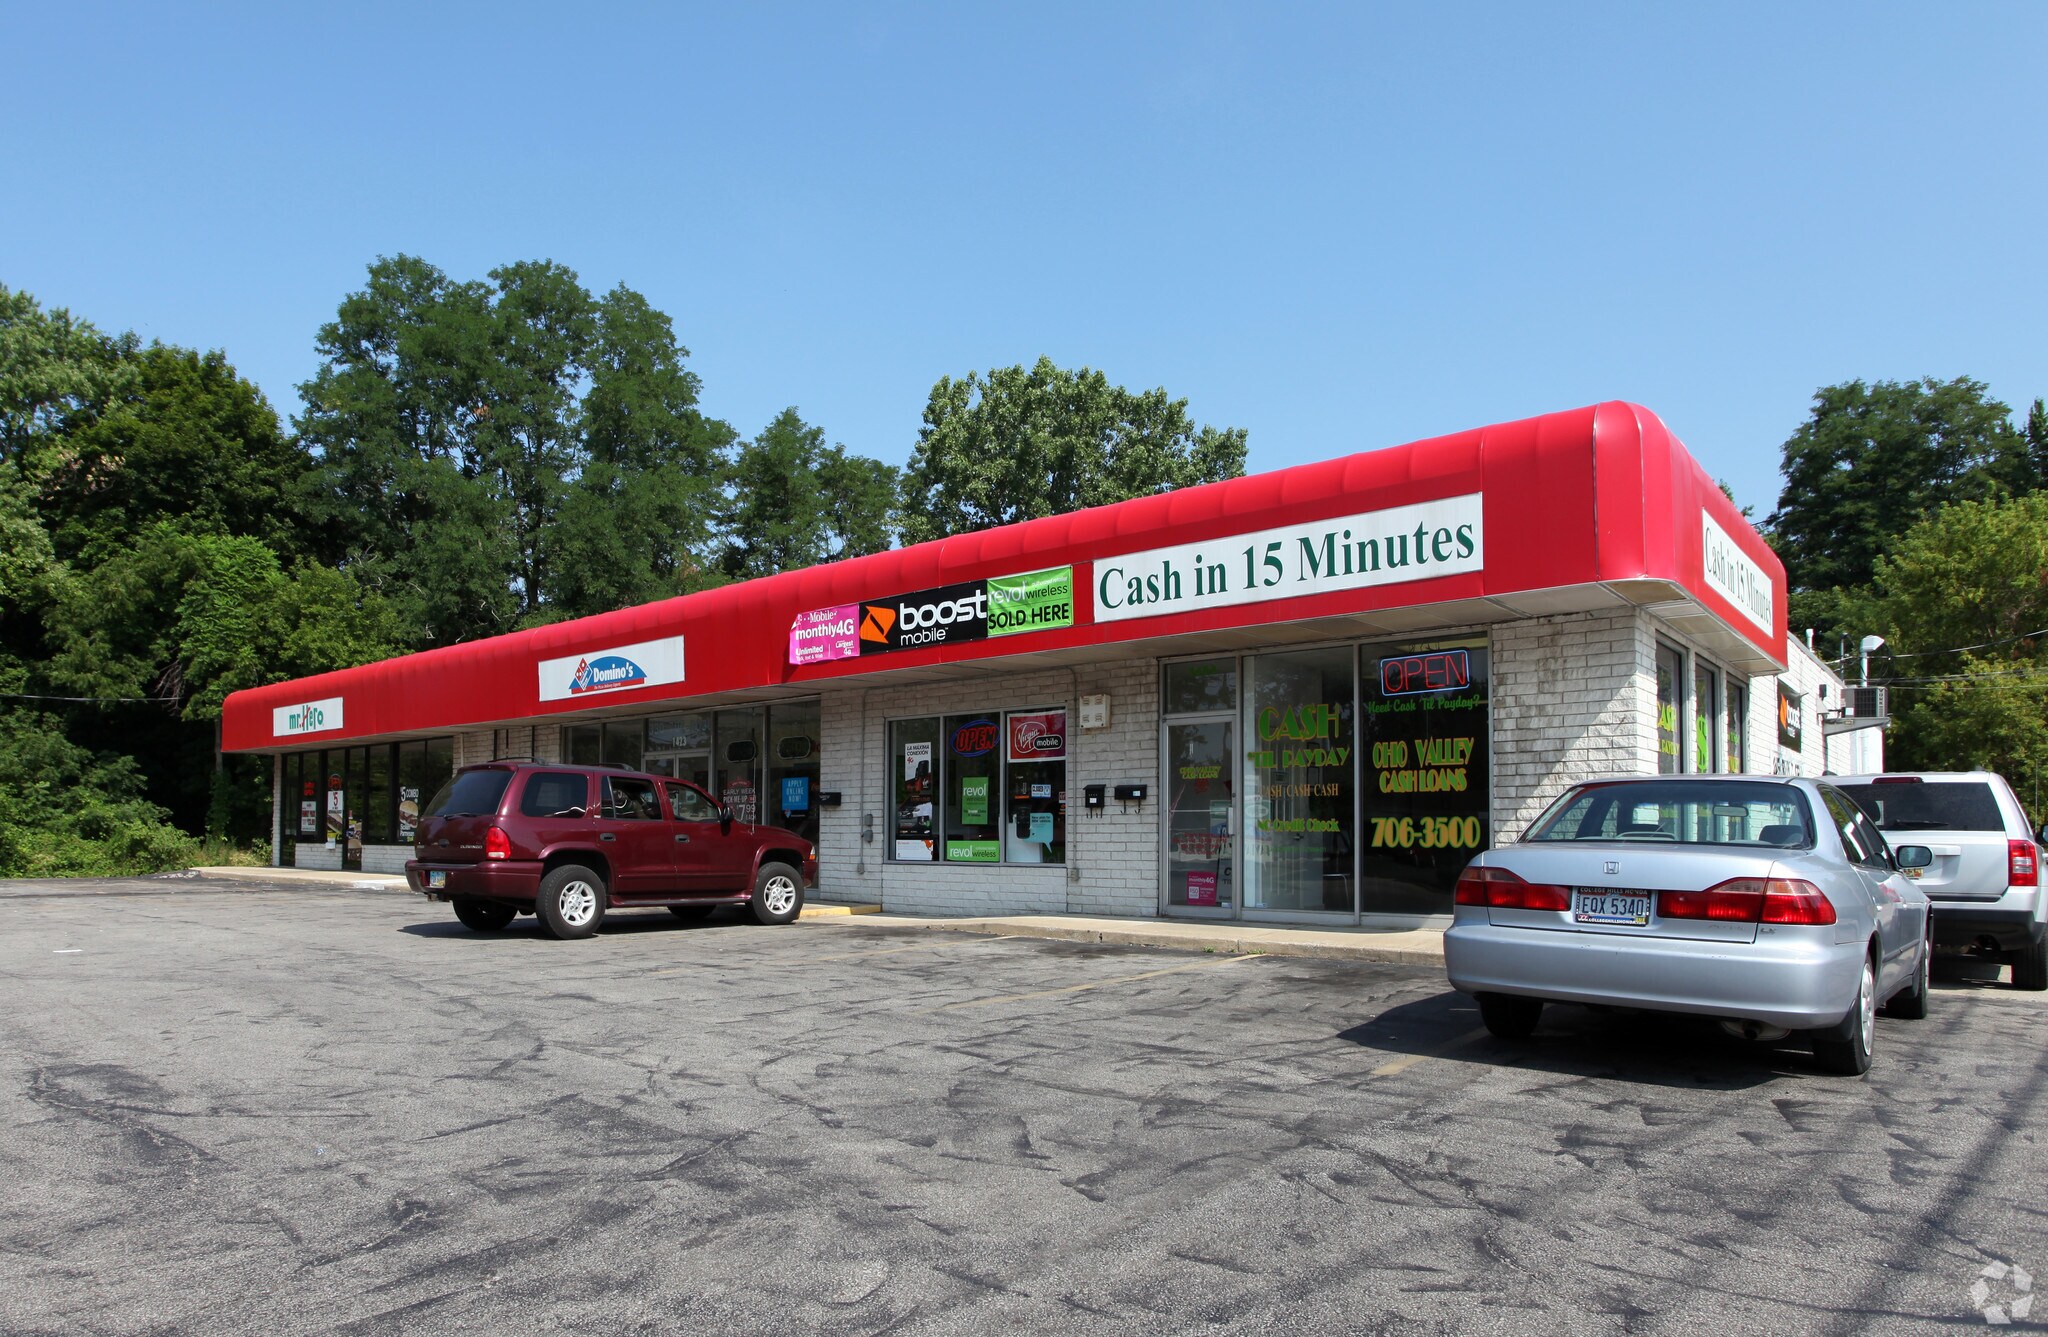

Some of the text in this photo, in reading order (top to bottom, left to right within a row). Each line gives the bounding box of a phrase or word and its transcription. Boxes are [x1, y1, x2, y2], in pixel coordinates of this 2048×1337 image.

[1100, 521, 1475, 609] Cash in 15 Minutes
[1705, 527, 1772, 626] Cash in 15 Minutes
[988, 581, 1068, 606] revol wireless
[900, 589, 988, 631] boost
[988, 603, 1070, 630] SOLD HERE
[900, 627, 947, 646] mobile
[796, 645, 823, 655] Unlimited
[593, 662, 634, 683] Domino's
[1384, 653, 1466, 692] OPEN
[1368, 701, 1390, 713] Need
[1393, 699, 1416, 711] Cash
[1438, 695, 1480, 711] Payday?
[1258, 703, 1340, 741] CASH
[956, 726, 997, 752] OPEN
[1018, 725, 1040, 749] Virgin
[1036, 738, 1059, 747] mobile
[1282, 746, 1350, 769] PAYDAY
[1372, 736, 1474, 769] OHIO VALLEY
[788, 780, 802, 788] APPLY
[963, 784, 986, 796] revol
[1379, 768, 1467, 793] CASH LOANS
[1273, 818, 1305, 832] Credit
[1306, 818, 1340, 832] Check
[1370, 816, 1480, 849] 706-3500
[950, 845, 996, 858] revol wireless
[1581, 897, 1644, 916] EQX 5340
